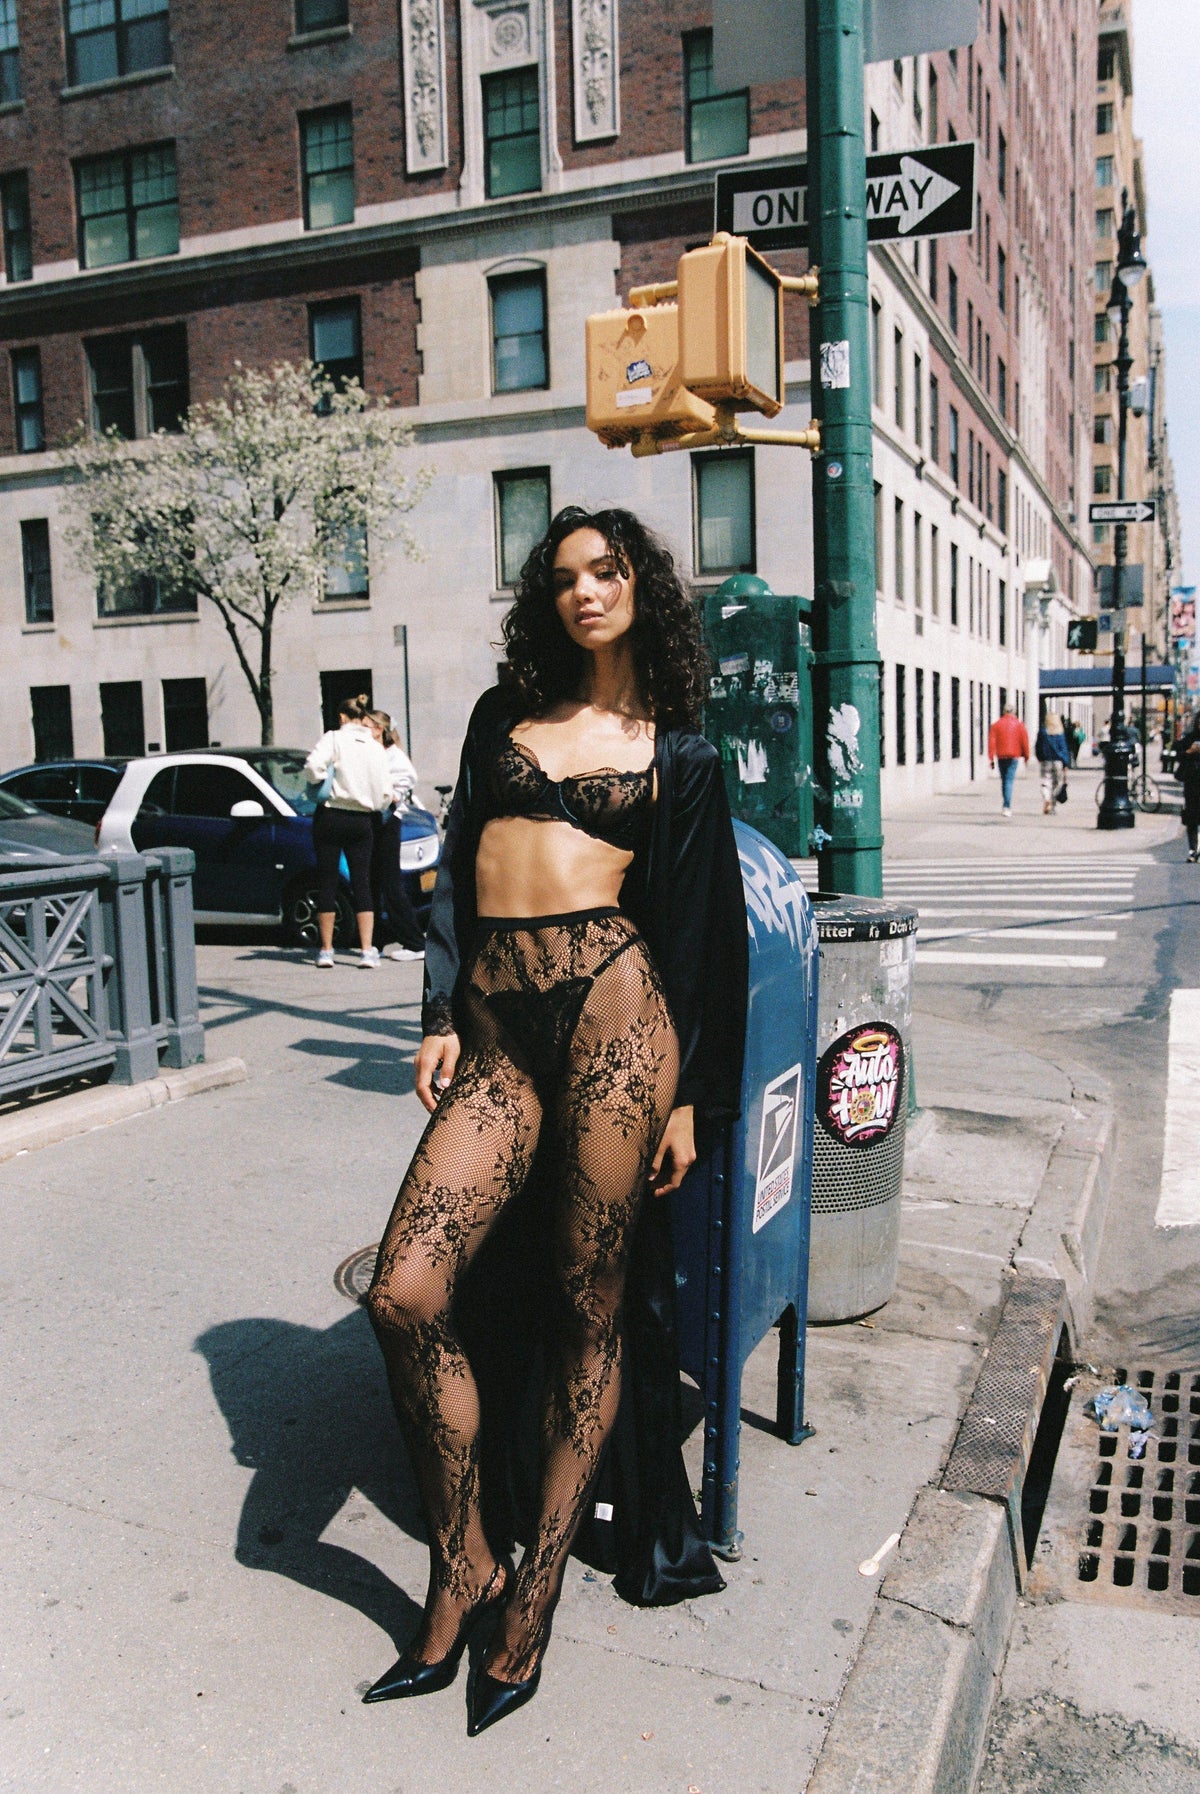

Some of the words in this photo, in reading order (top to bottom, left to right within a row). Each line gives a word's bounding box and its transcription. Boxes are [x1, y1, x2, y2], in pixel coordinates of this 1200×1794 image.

[866, 176, 933, 214] WAY
[818, 925, 855, 938] itter
[756, 1199, 773, 1223] POSTAL
[772, 1181, 790, 1207] SERVICE
[758, 1179, 775, 1205] UNITED
[774, 1166, 790, 1190] STATES
